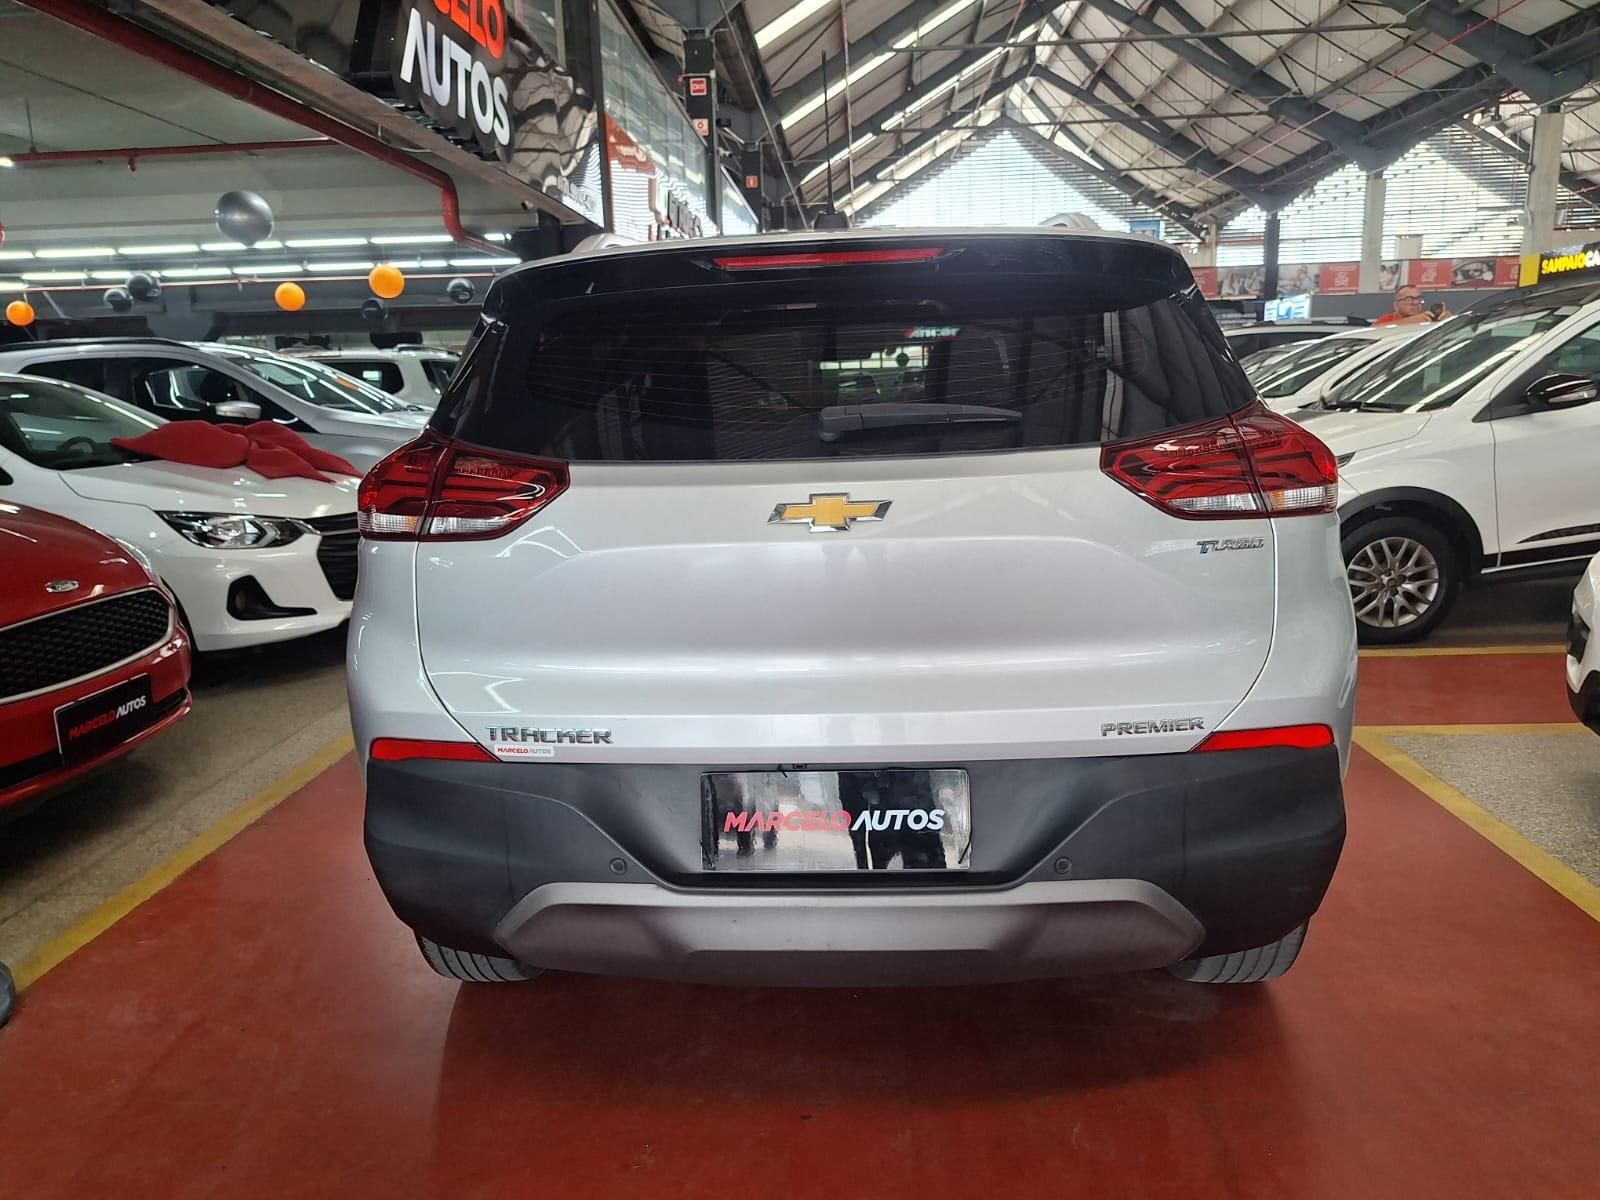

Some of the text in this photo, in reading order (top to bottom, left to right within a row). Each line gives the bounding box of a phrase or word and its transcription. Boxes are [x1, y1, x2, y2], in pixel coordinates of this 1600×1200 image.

[400, 7, 511, 146] AUTOS
[1196, 537, 1264, 554] TURBO
[68, 696, 147, 740] MARCELO AUTOS
[1101, 717, 1205, 737] PREMIER
[485, 726, 614, 745] TRACKER
[723, 809, 946, 832] MARCELO AUTOS
